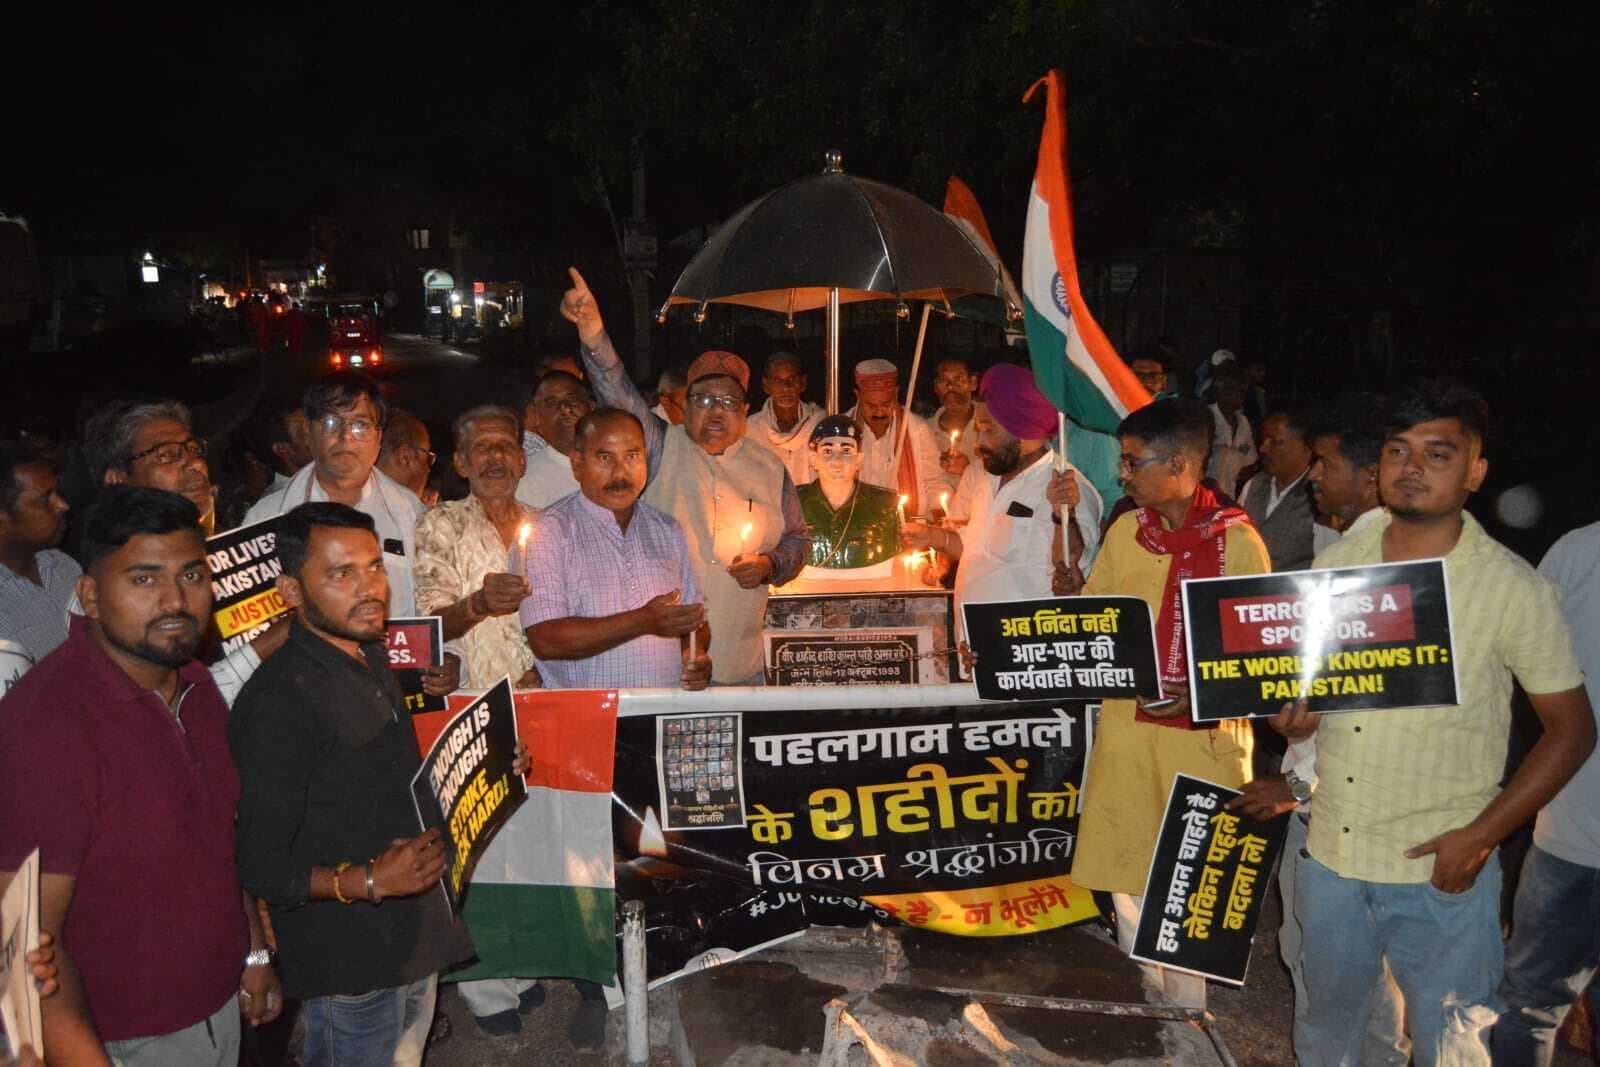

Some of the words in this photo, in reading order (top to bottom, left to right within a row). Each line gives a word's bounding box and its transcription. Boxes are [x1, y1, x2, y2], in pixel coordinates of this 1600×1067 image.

[230, 532, 276, 566] LIVES
[212, 557, 283, 602] AKISTAN
[1380, 593, 1398, 612] A
[1001, 616, 1032, 638] अब
[1034, 608, 1077, 636] निंदा
[1079, 607, 1120, 634] नहीं
[1011, 641, 1088, 664] आर-पार
[1088, 635, 1116, 661] की
[1198, 660, 1241, 680] THE
[1329, 647, 1412, 672] KNOWS
[1415, 644, 1448, 665] IT:
[995, 663, 1073, 691] कार्यवाही
[1074, 662, 1136, 689] चाहिए!
[1261, 673, 1385, 700] PAKISTAN!
[429, 715, 477, 797] ENOUGH
[474, 702, 490, 734] IS
[749, 724, 953, 767] पहलगाम
[959, 708, 1076, 752] हमले
[439, 733, 488, 820] ENOUGH!
[746, 804, 794, 844] के
[808, 757, 1029, 841] शहीदों
[1027, 782, 1080, 821] को
[451, 768, 489, 844] STRIKE
[470, 773, 510, 842] HARD!
[746, 850, 887, 886] विनम्र
[900, 827, 1076, 880] श्रद्धांजलि
[1177, 809, 1209, 861] चाहते
[1237, 833, 1268, 864] लो
[1164, 861, 1193, 918] अमन
[1183, 864, 1225, 940] लेकिन
[1206, 811, 1240, 863] पहले
[1222, 864, 1259, 930] बदला
[960, 901, 993, 926] न
[1156, 918, 1180, 953] हम
